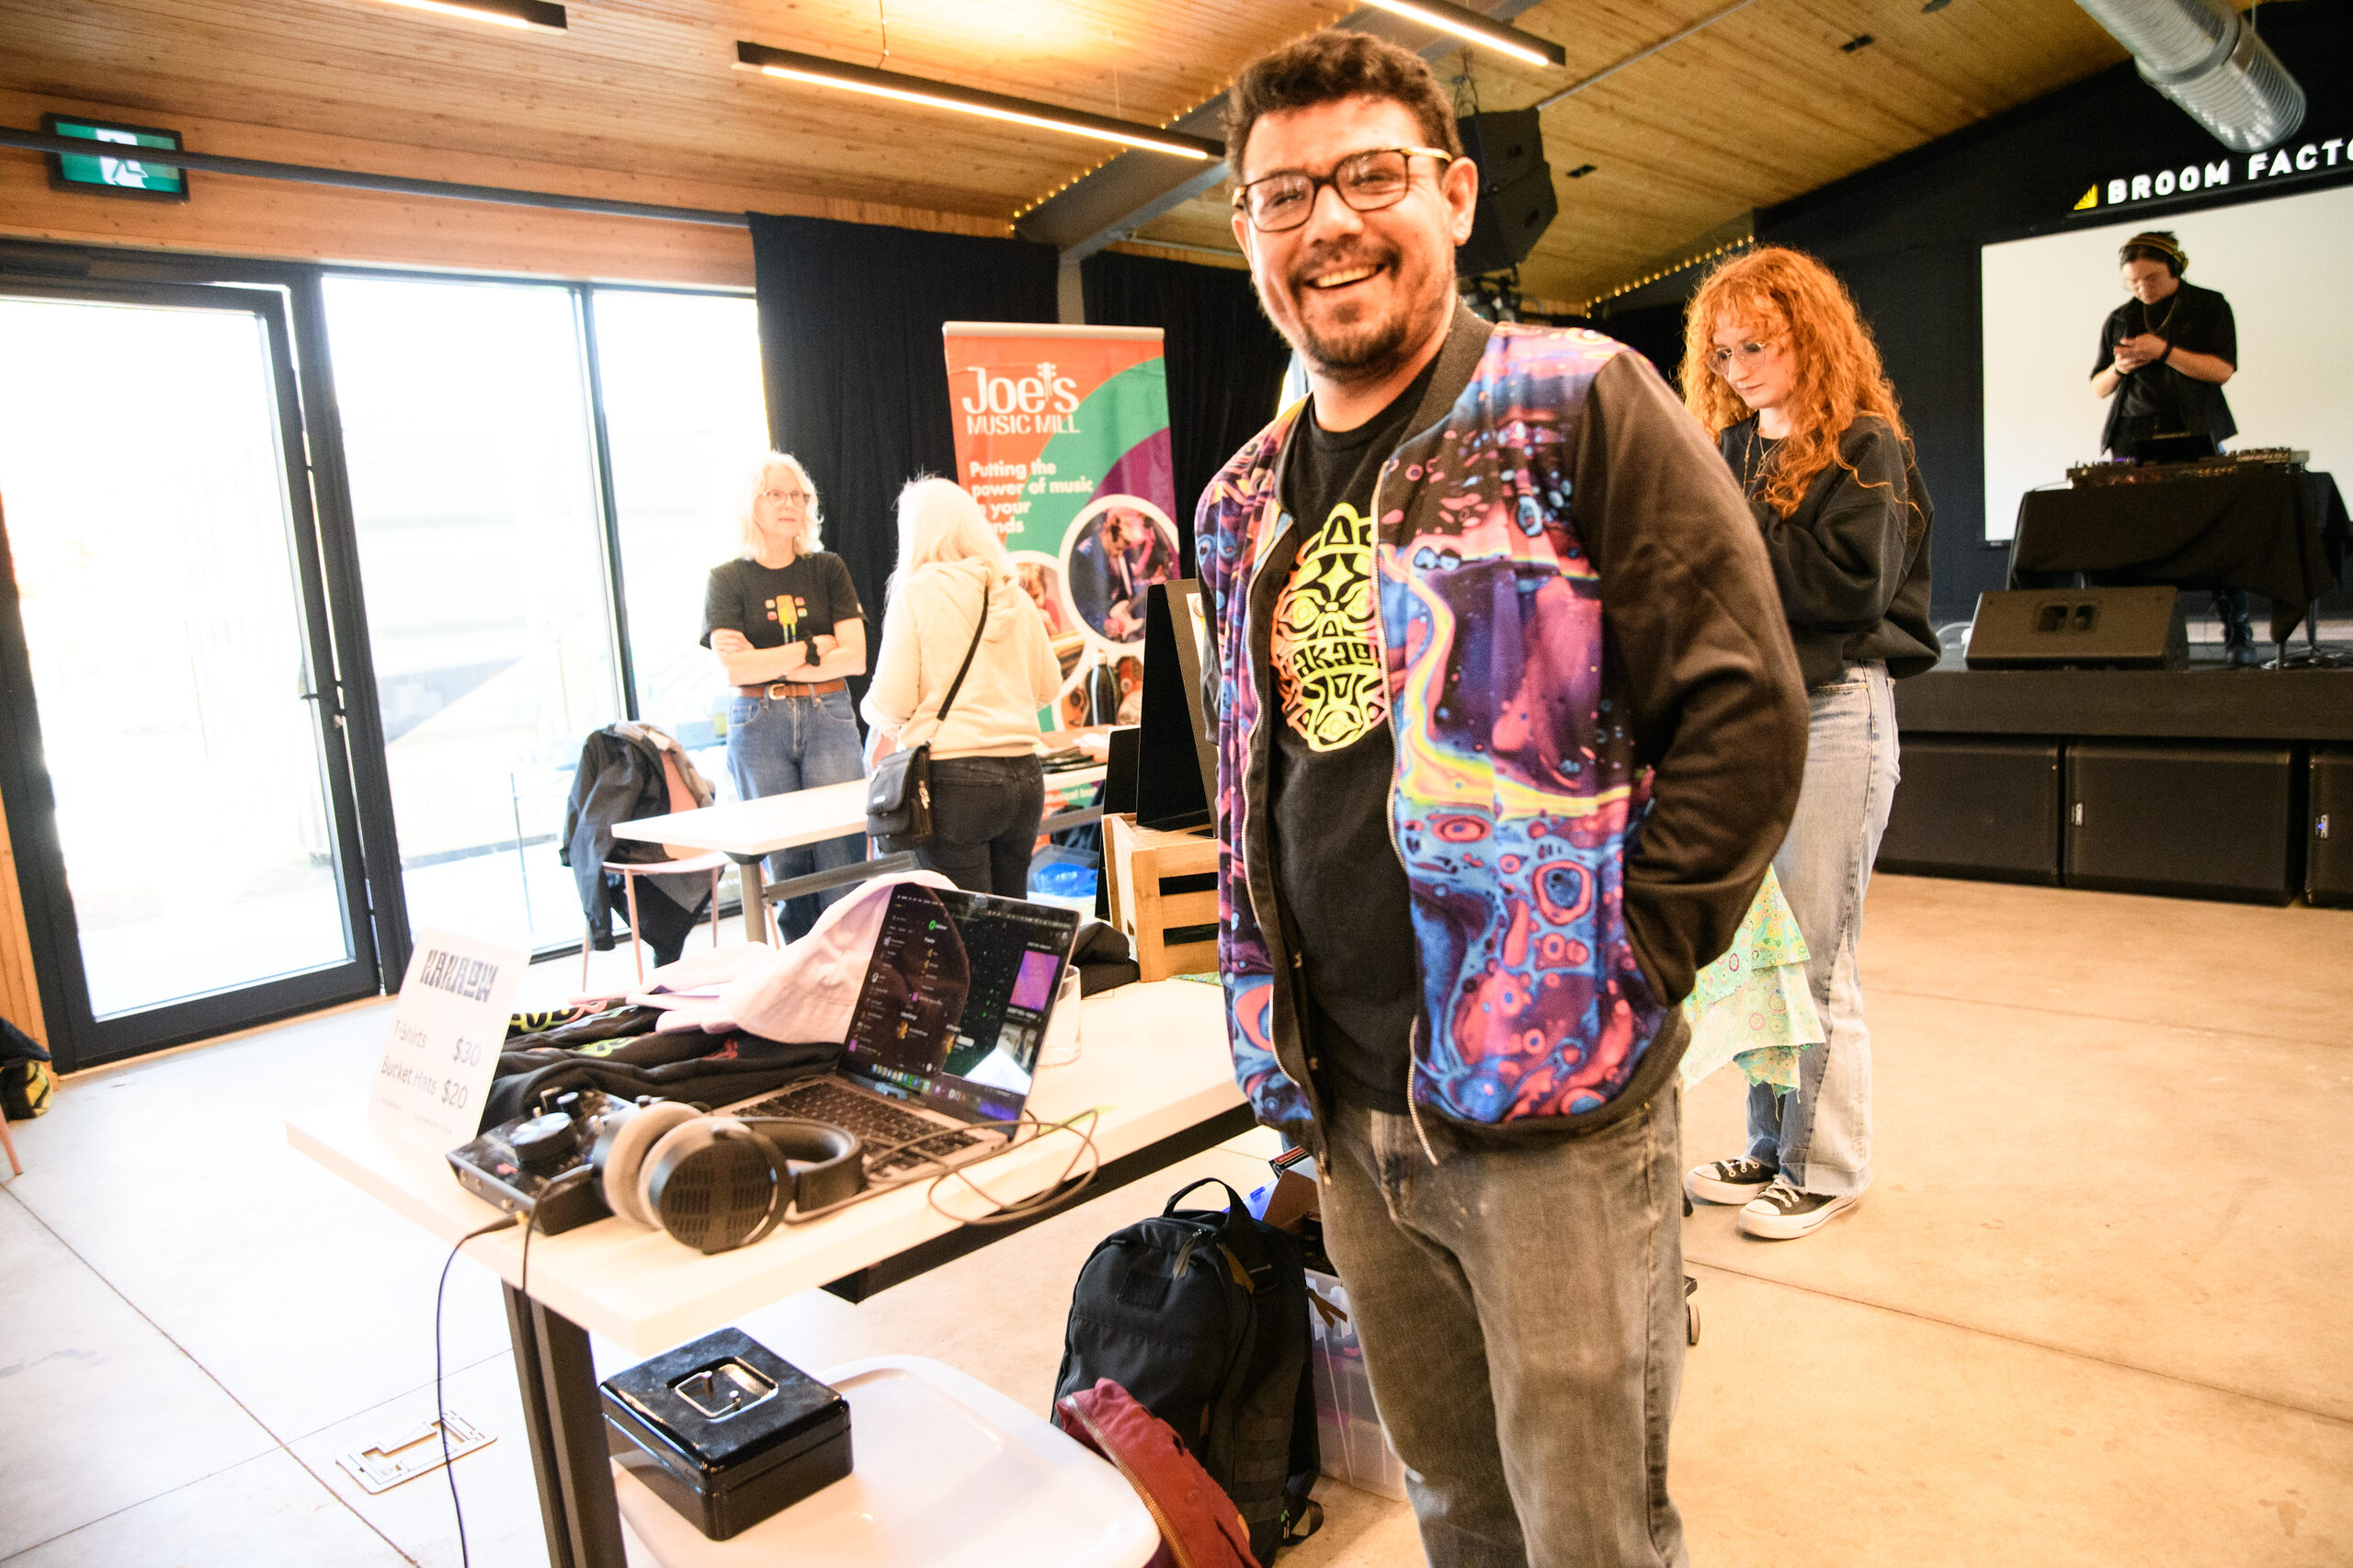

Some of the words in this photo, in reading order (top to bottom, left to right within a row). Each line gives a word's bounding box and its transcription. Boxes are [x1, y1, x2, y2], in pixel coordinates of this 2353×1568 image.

[2108, 159, 2230, 205] BROOM
[961, 362, 1079, 415] Joe's
[966, 415, 1031, 436] MUSIC
[1035, 415, 1081, 434] MILL
[970, 460, 1028, 480] Putting
[1030, 458, 1057, 475] the
[971, 482, 1024, 501] power
[1028, 476, 1047, 494] of
[1049, 475, 1094, 494] music
[990, 501, 1031, 520] your
[392, 1019, 428, 1050] T-Shirts
[452, 1035, 483, 1066] $30
[381, 1054, 413, 1085] Bucket
[413, 1069, 438, 1096] Hats
[441, 1079, 469, 1110] $20
